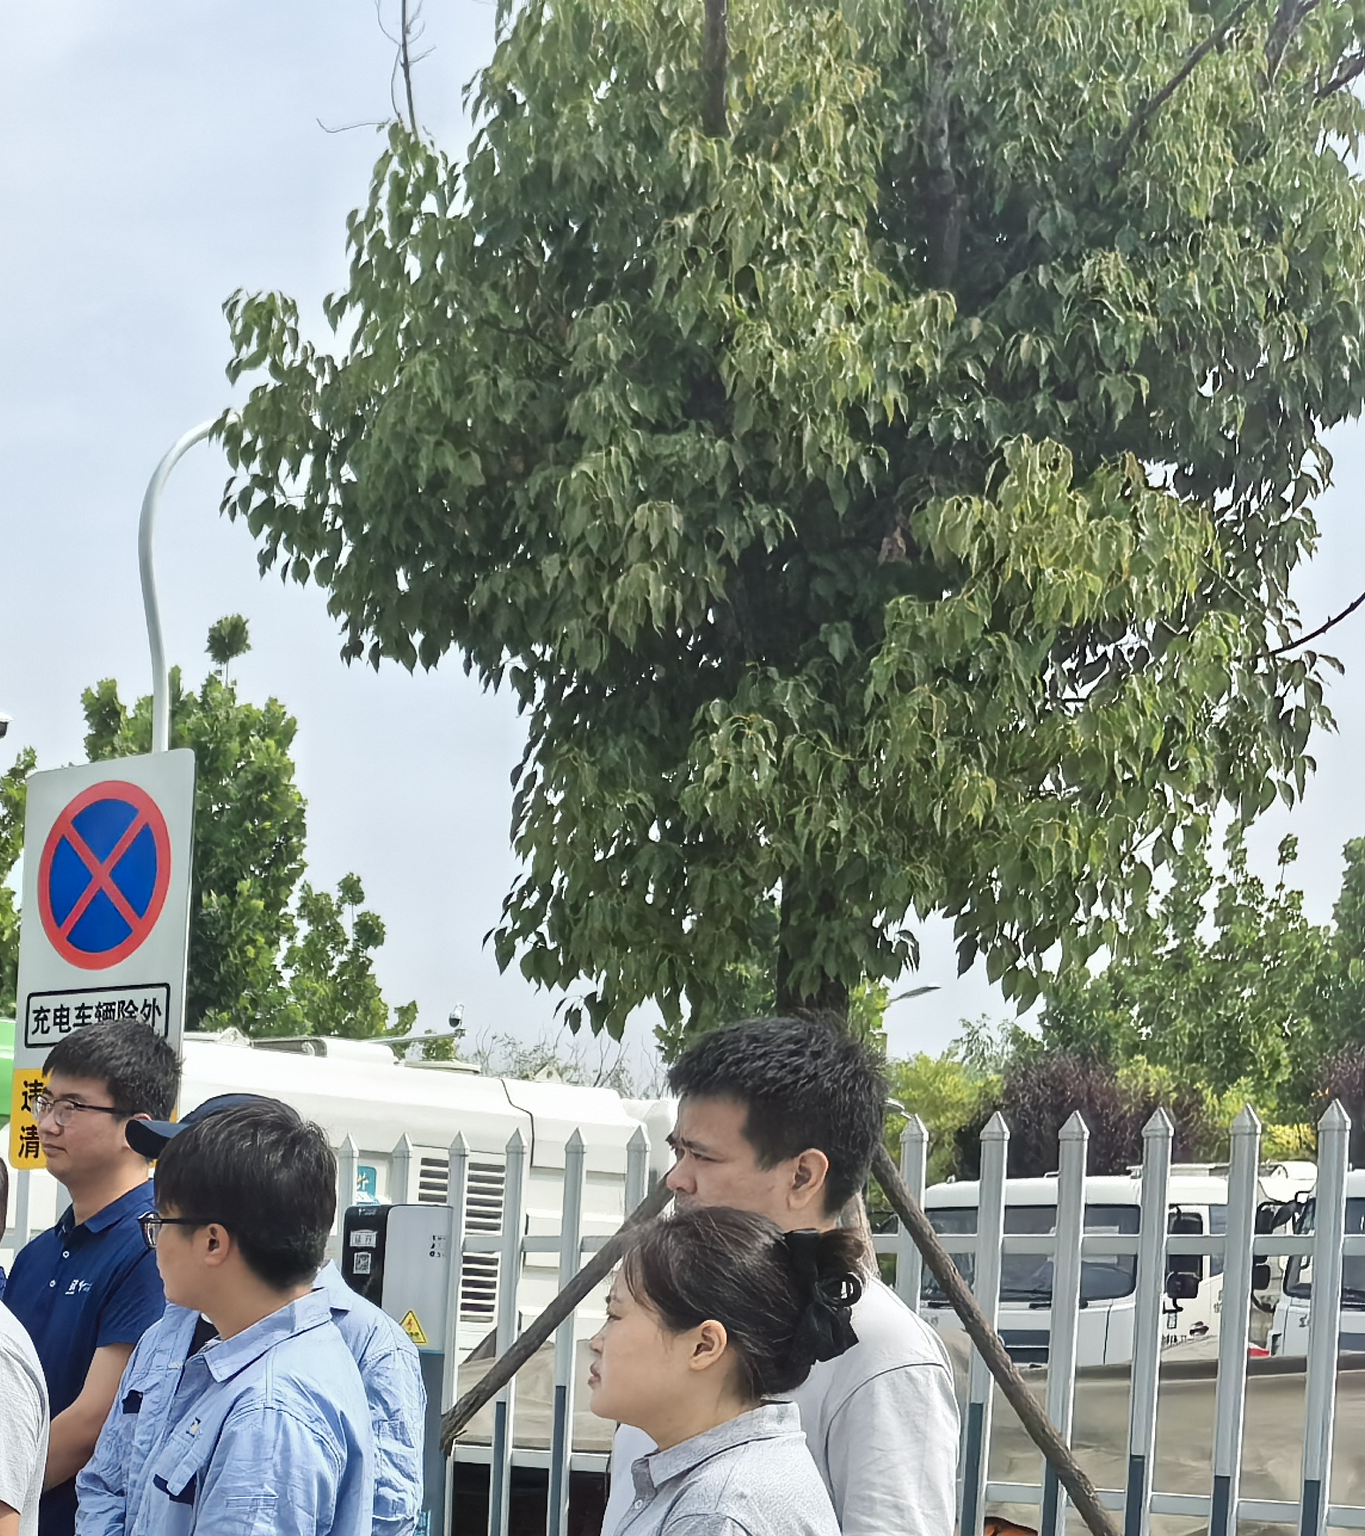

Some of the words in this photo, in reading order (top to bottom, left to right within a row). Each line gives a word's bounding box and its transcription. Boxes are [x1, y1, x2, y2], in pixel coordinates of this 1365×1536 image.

[31, 997, 162, 1035] 充电车辆除外
